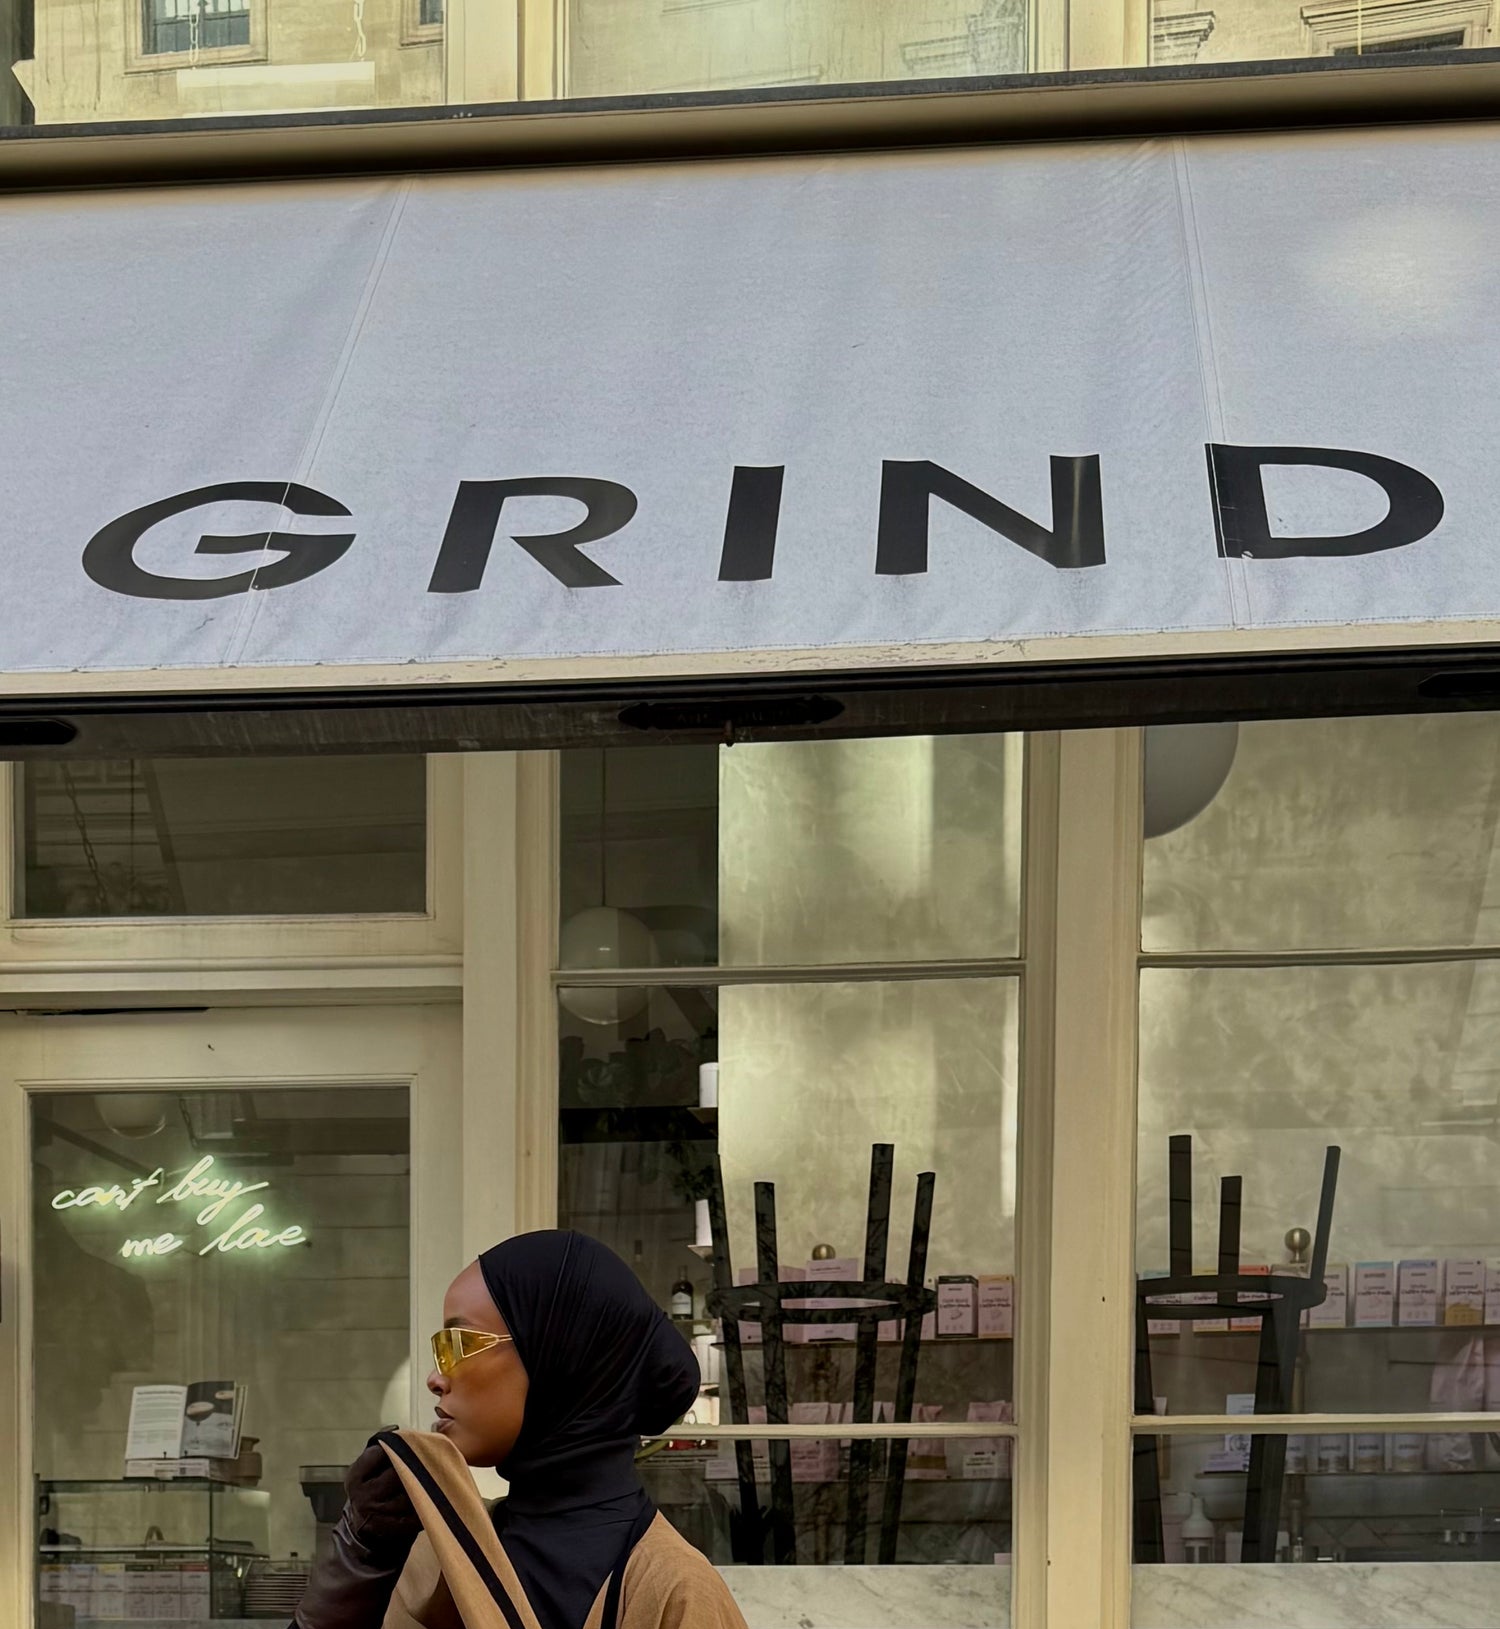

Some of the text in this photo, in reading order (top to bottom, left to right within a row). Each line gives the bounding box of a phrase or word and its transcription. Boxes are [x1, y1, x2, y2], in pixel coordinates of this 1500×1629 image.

[82, 443, 1445, 600] GRIND
[156, 1155, 269, 1225] buy
[121, 1203, 306, 1257] me love
